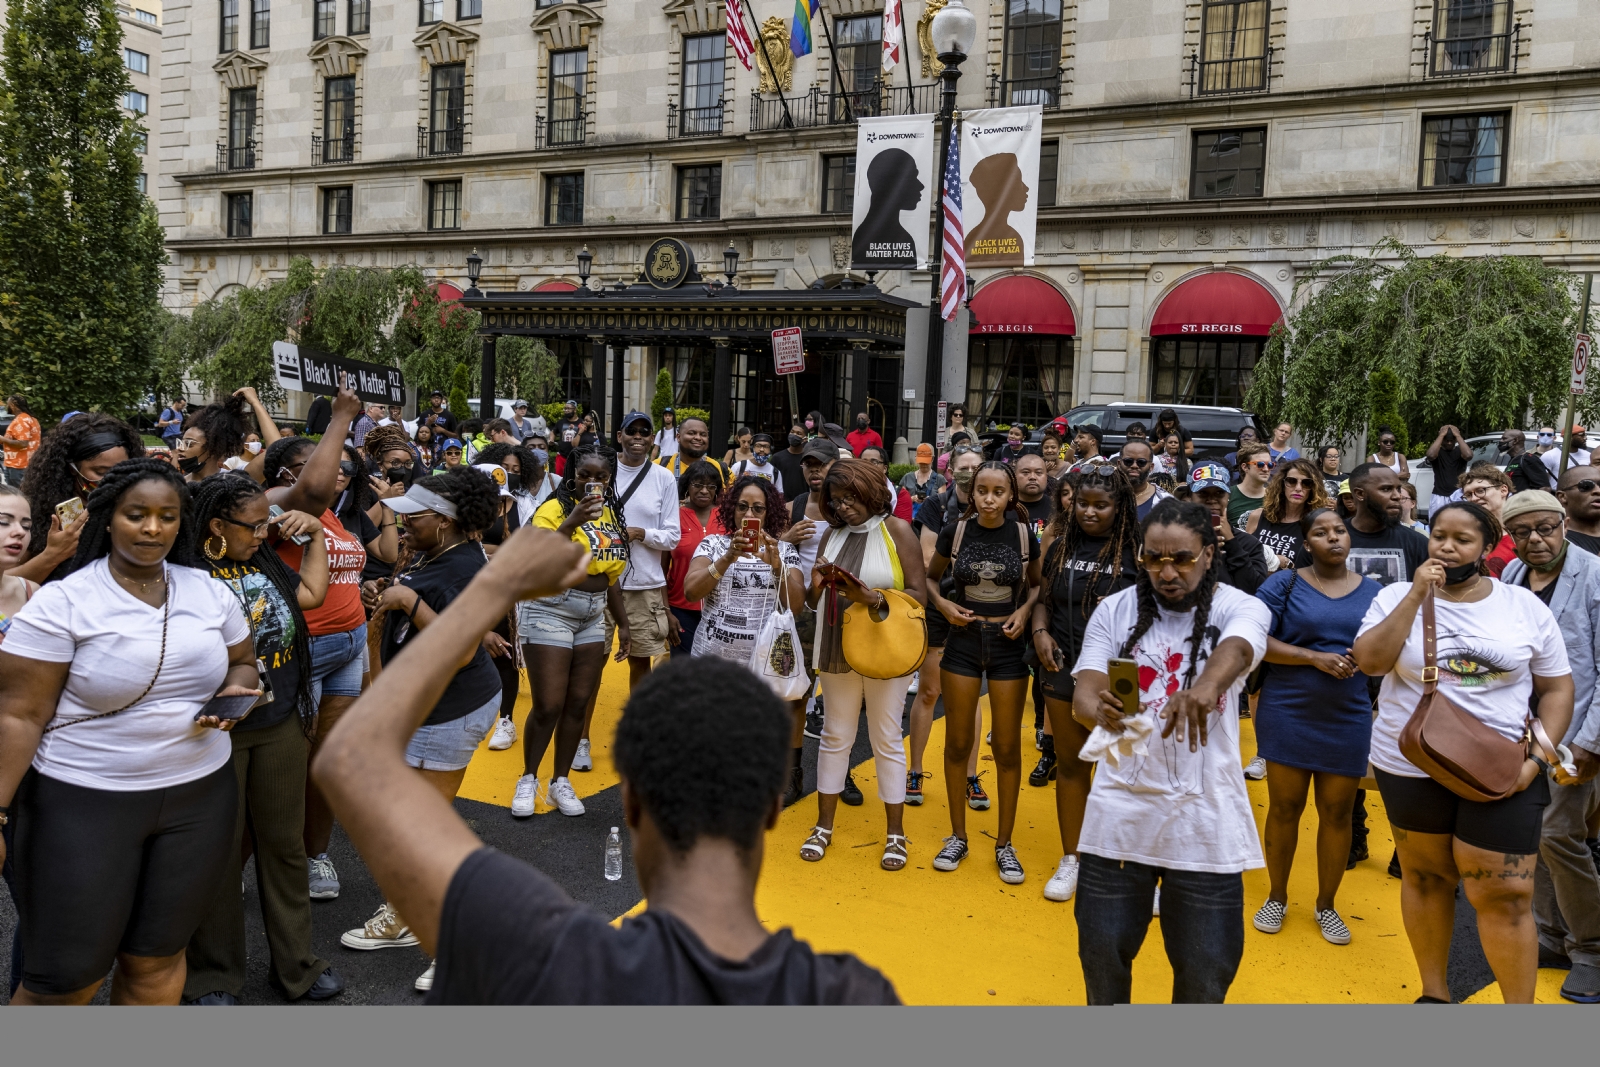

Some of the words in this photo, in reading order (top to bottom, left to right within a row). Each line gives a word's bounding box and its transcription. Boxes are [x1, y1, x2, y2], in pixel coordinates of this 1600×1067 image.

[984, 126, 1024, 135] DOWNTOWN
[878, 133, 917, 141] DOWNTOWN
[869, 242, 891, 250] BLACK
[892, 242, 911, 250] LIVES
[975, 239, 997, 247] BLACK
[998, 238, 1017, 246] LIVES
[866, 250, 892, 258] MATTER
[893, 250, 914, 258] PLAZA
[971, 247, 998, 255] MATTER
[998, 246, 1020, 254] PLAZA
[981, 324, 995, 332] ST.
[998, 324, 1033, 332] REGIS
[1181, 324, 1198, 333] ST.
[1201, 324, 1243, 333] REGIS
[304, 358, 332, 387] Black
[359, 370, 387, 396] Matter
[388, 371, 401, 387] PLZ
[1259, 528, 1297, 544] BLACK
[1258, 536, 1291, 549] LIVES
[592, 548, 627, 561] FATHE
[327, 554, 364, 568] HARRIET
